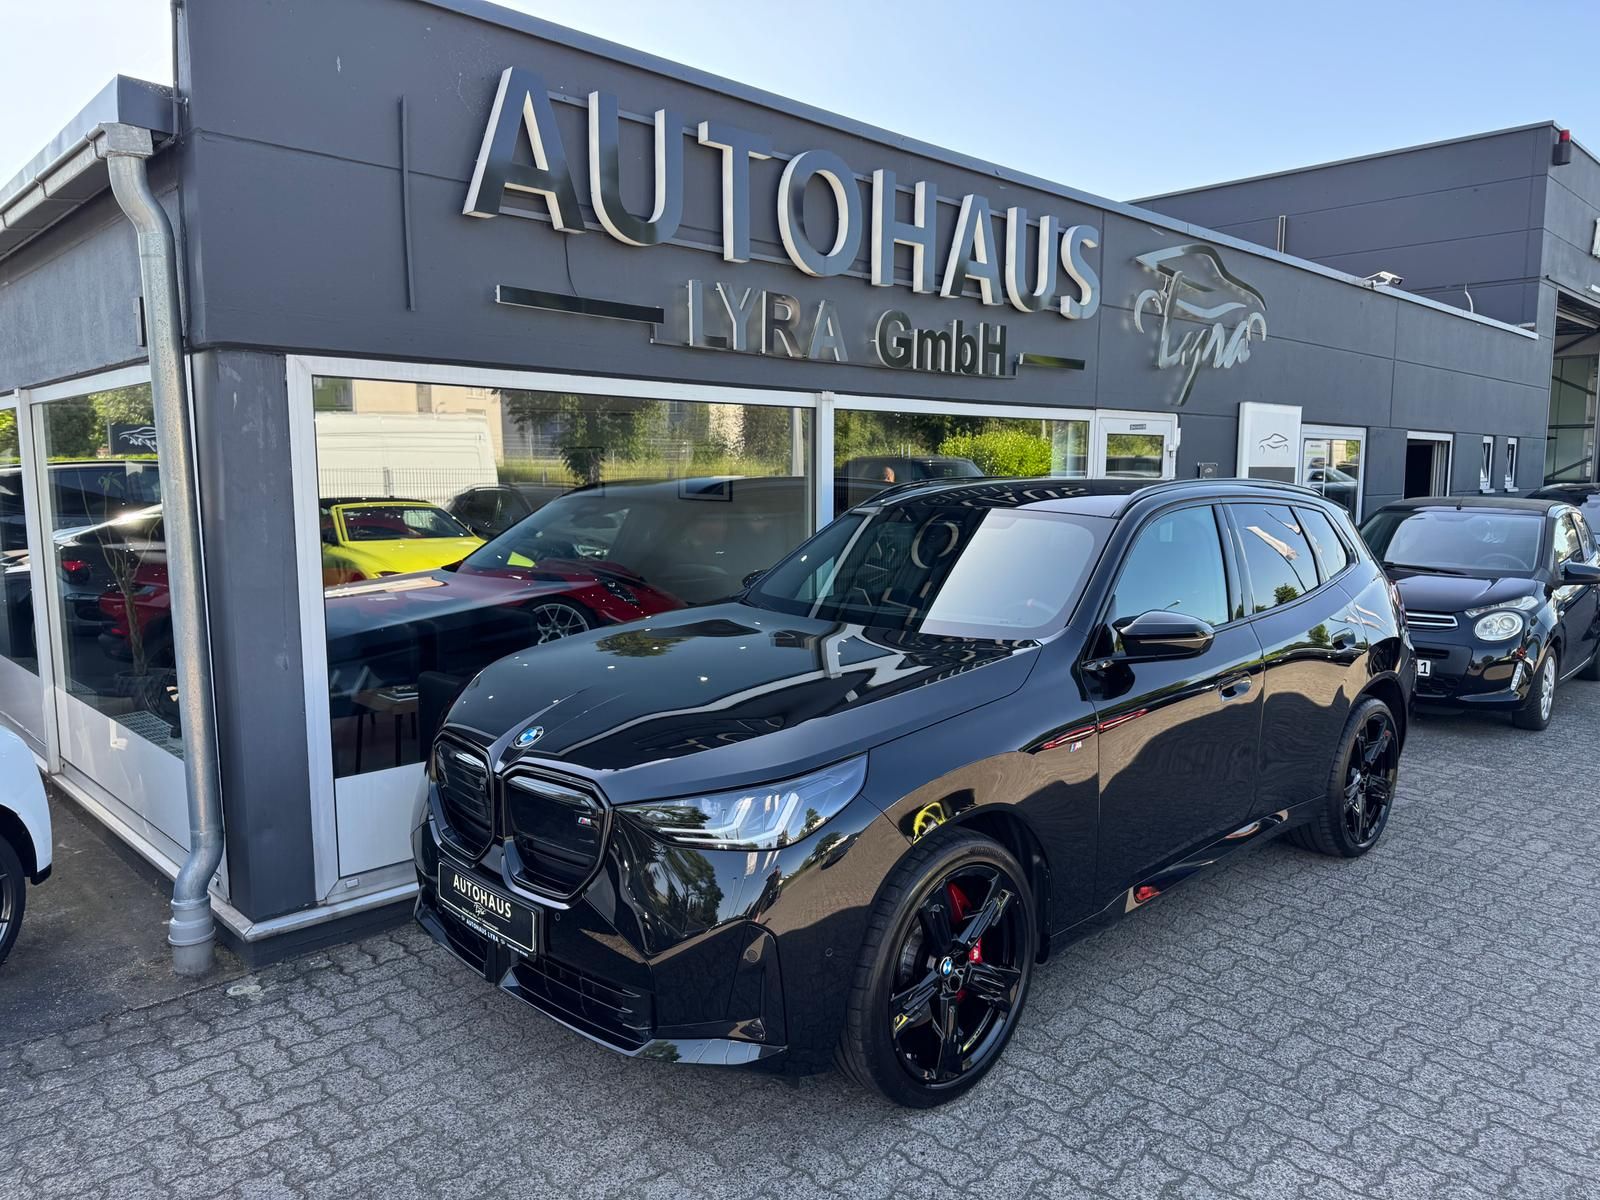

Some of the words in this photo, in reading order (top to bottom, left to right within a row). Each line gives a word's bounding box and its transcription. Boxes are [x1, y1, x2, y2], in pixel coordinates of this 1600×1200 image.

[463, 66, 1100, 320] AUTOHAUS
[687, 279, 849, 363] LYRA
[874, 309, 1008, 377] GmbH
[453, 874, 512, 918] AUTOHAUS
[487, 931, 499, 943] LYRA
